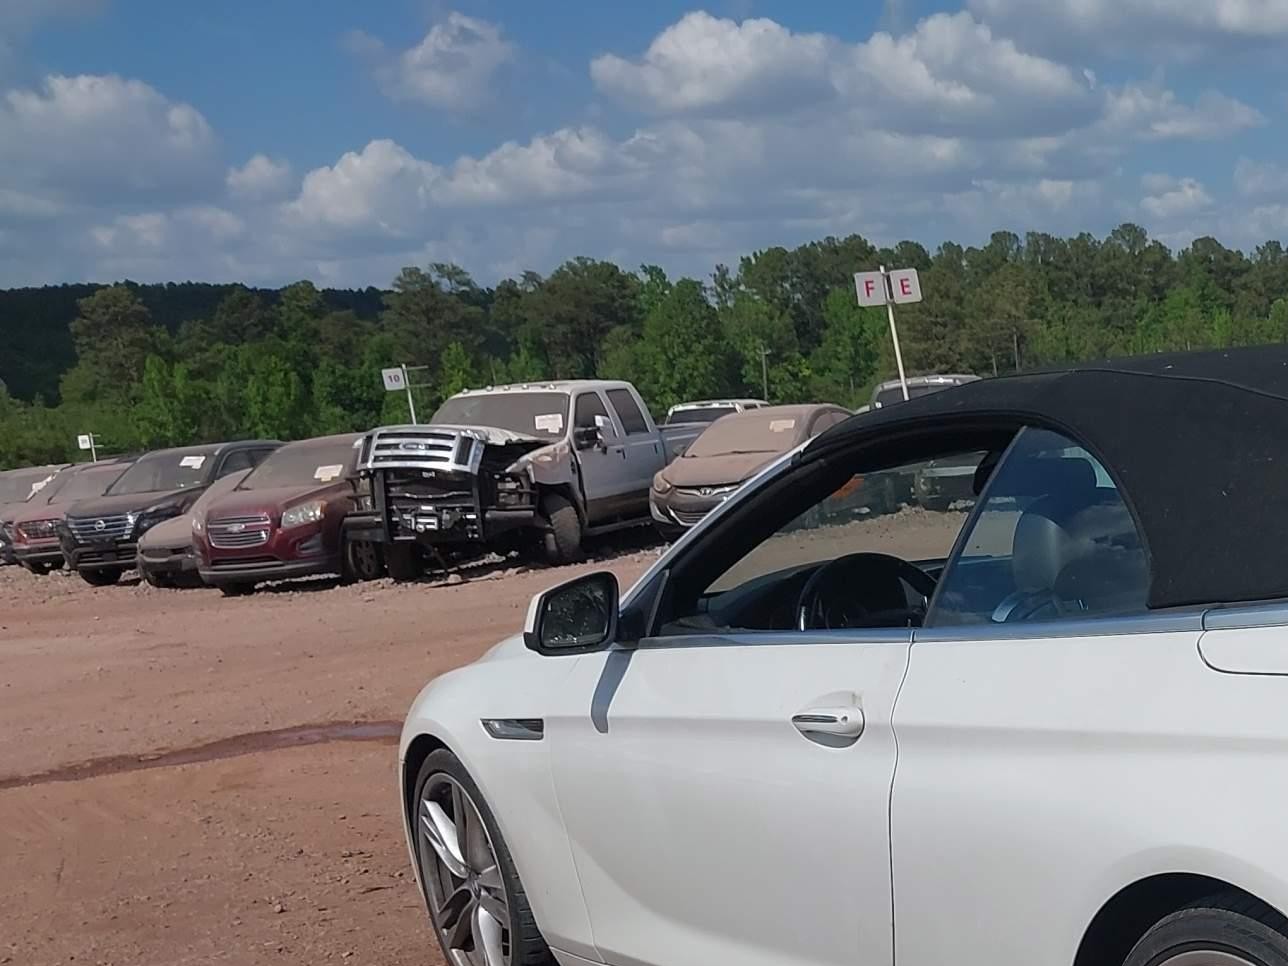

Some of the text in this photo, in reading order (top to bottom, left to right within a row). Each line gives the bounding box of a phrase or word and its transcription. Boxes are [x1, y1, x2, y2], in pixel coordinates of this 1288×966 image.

[864, 280, 875, 299] F
[900, 278, 912, 295] E
[388, 374, 401, 384] 10
